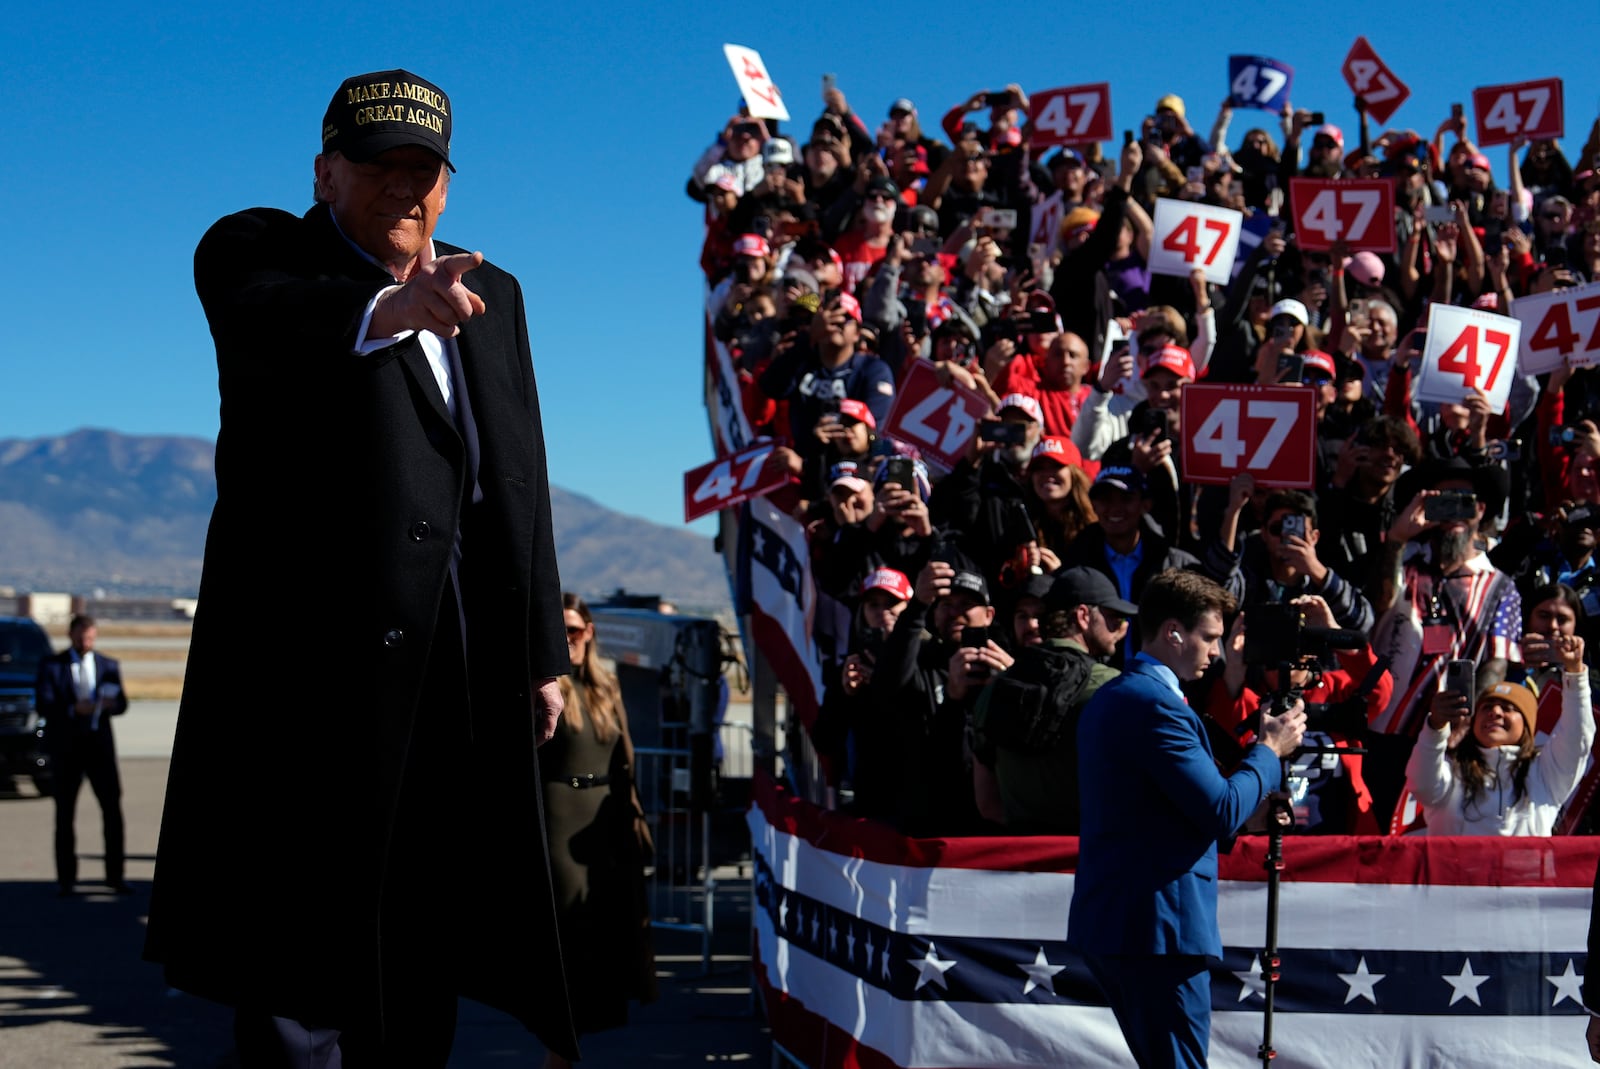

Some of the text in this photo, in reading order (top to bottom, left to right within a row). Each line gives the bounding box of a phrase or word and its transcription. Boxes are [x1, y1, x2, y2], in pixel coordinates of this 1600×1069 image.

[347, 82, 448, 116] MAKE AMERICA
[1231, 64, 1288, 103] 47
[1348, 59, 1400, 105] 47
[356, 105, 443, 136] GREAT AGAIN
[1034, 92, 1101, 137] 47
[1484, 88, 1551, 134] 47
[1302, 189, 1381, 241] 47
[1163, 216, 1231, 265] 47
[1438, 326, 1510, 390] 47
[799, 372, 847, 399] USA
[901, 390, 976, 455] 47
[1193, 400, 1300, 470] 47
[692, 448, 774, 503] 47
